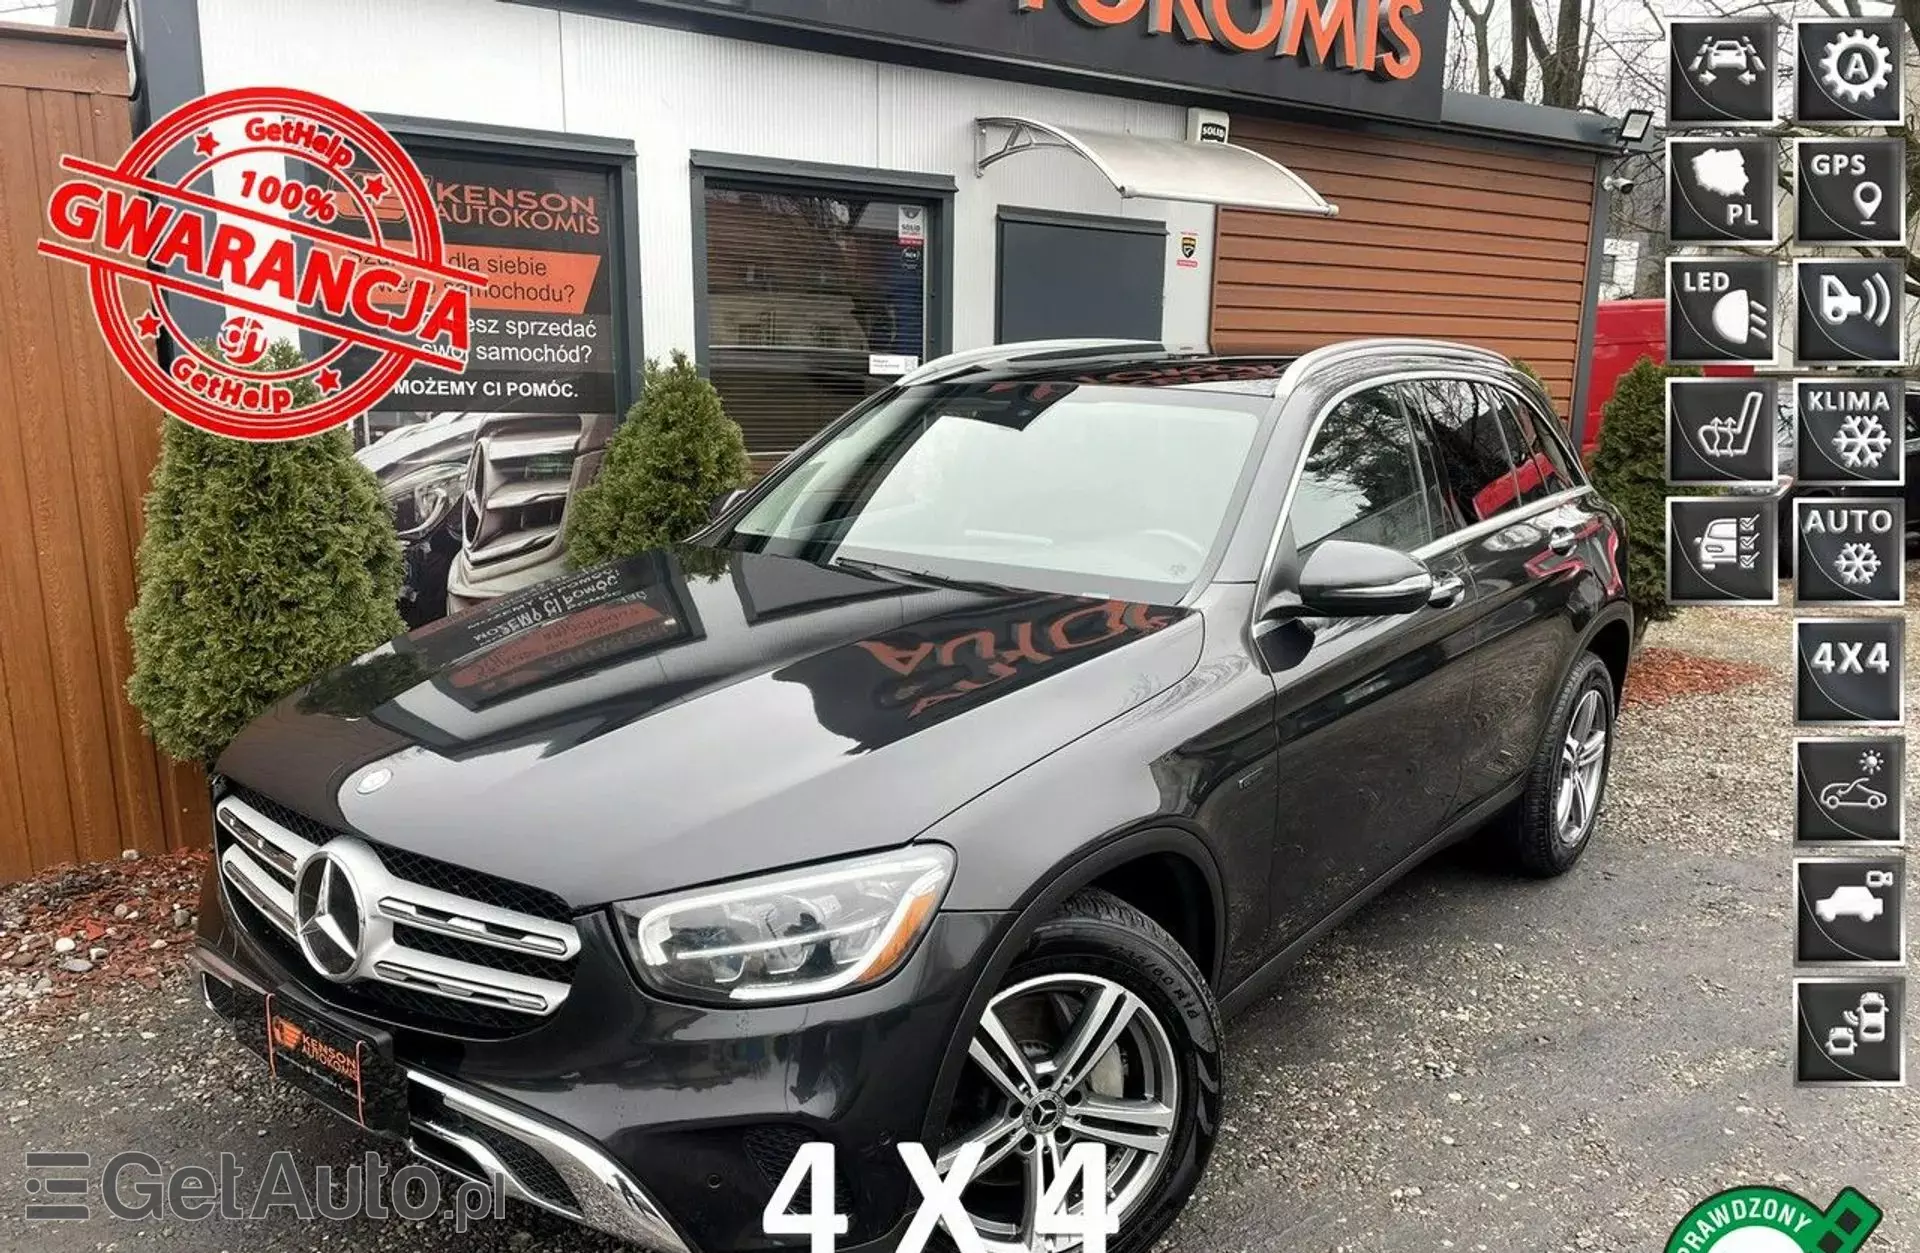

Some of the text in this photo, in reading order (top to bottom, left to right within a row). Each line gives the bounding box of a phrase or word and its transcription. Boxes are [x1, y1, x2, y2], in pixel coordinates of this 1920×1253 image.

[436, 182, 595, 216] KENSON
[437, 203, 601, 236] AUTOKOMIS
[449, 251, 548, 277] dla siebie
[505, 319, 598, 339] sprzedać
[475, 344, 593, 364] samochód?
[394, 376, 579, 398] MOŻEMY CI POMÓC.
[302, 1033, 357, 1070] KENSON
